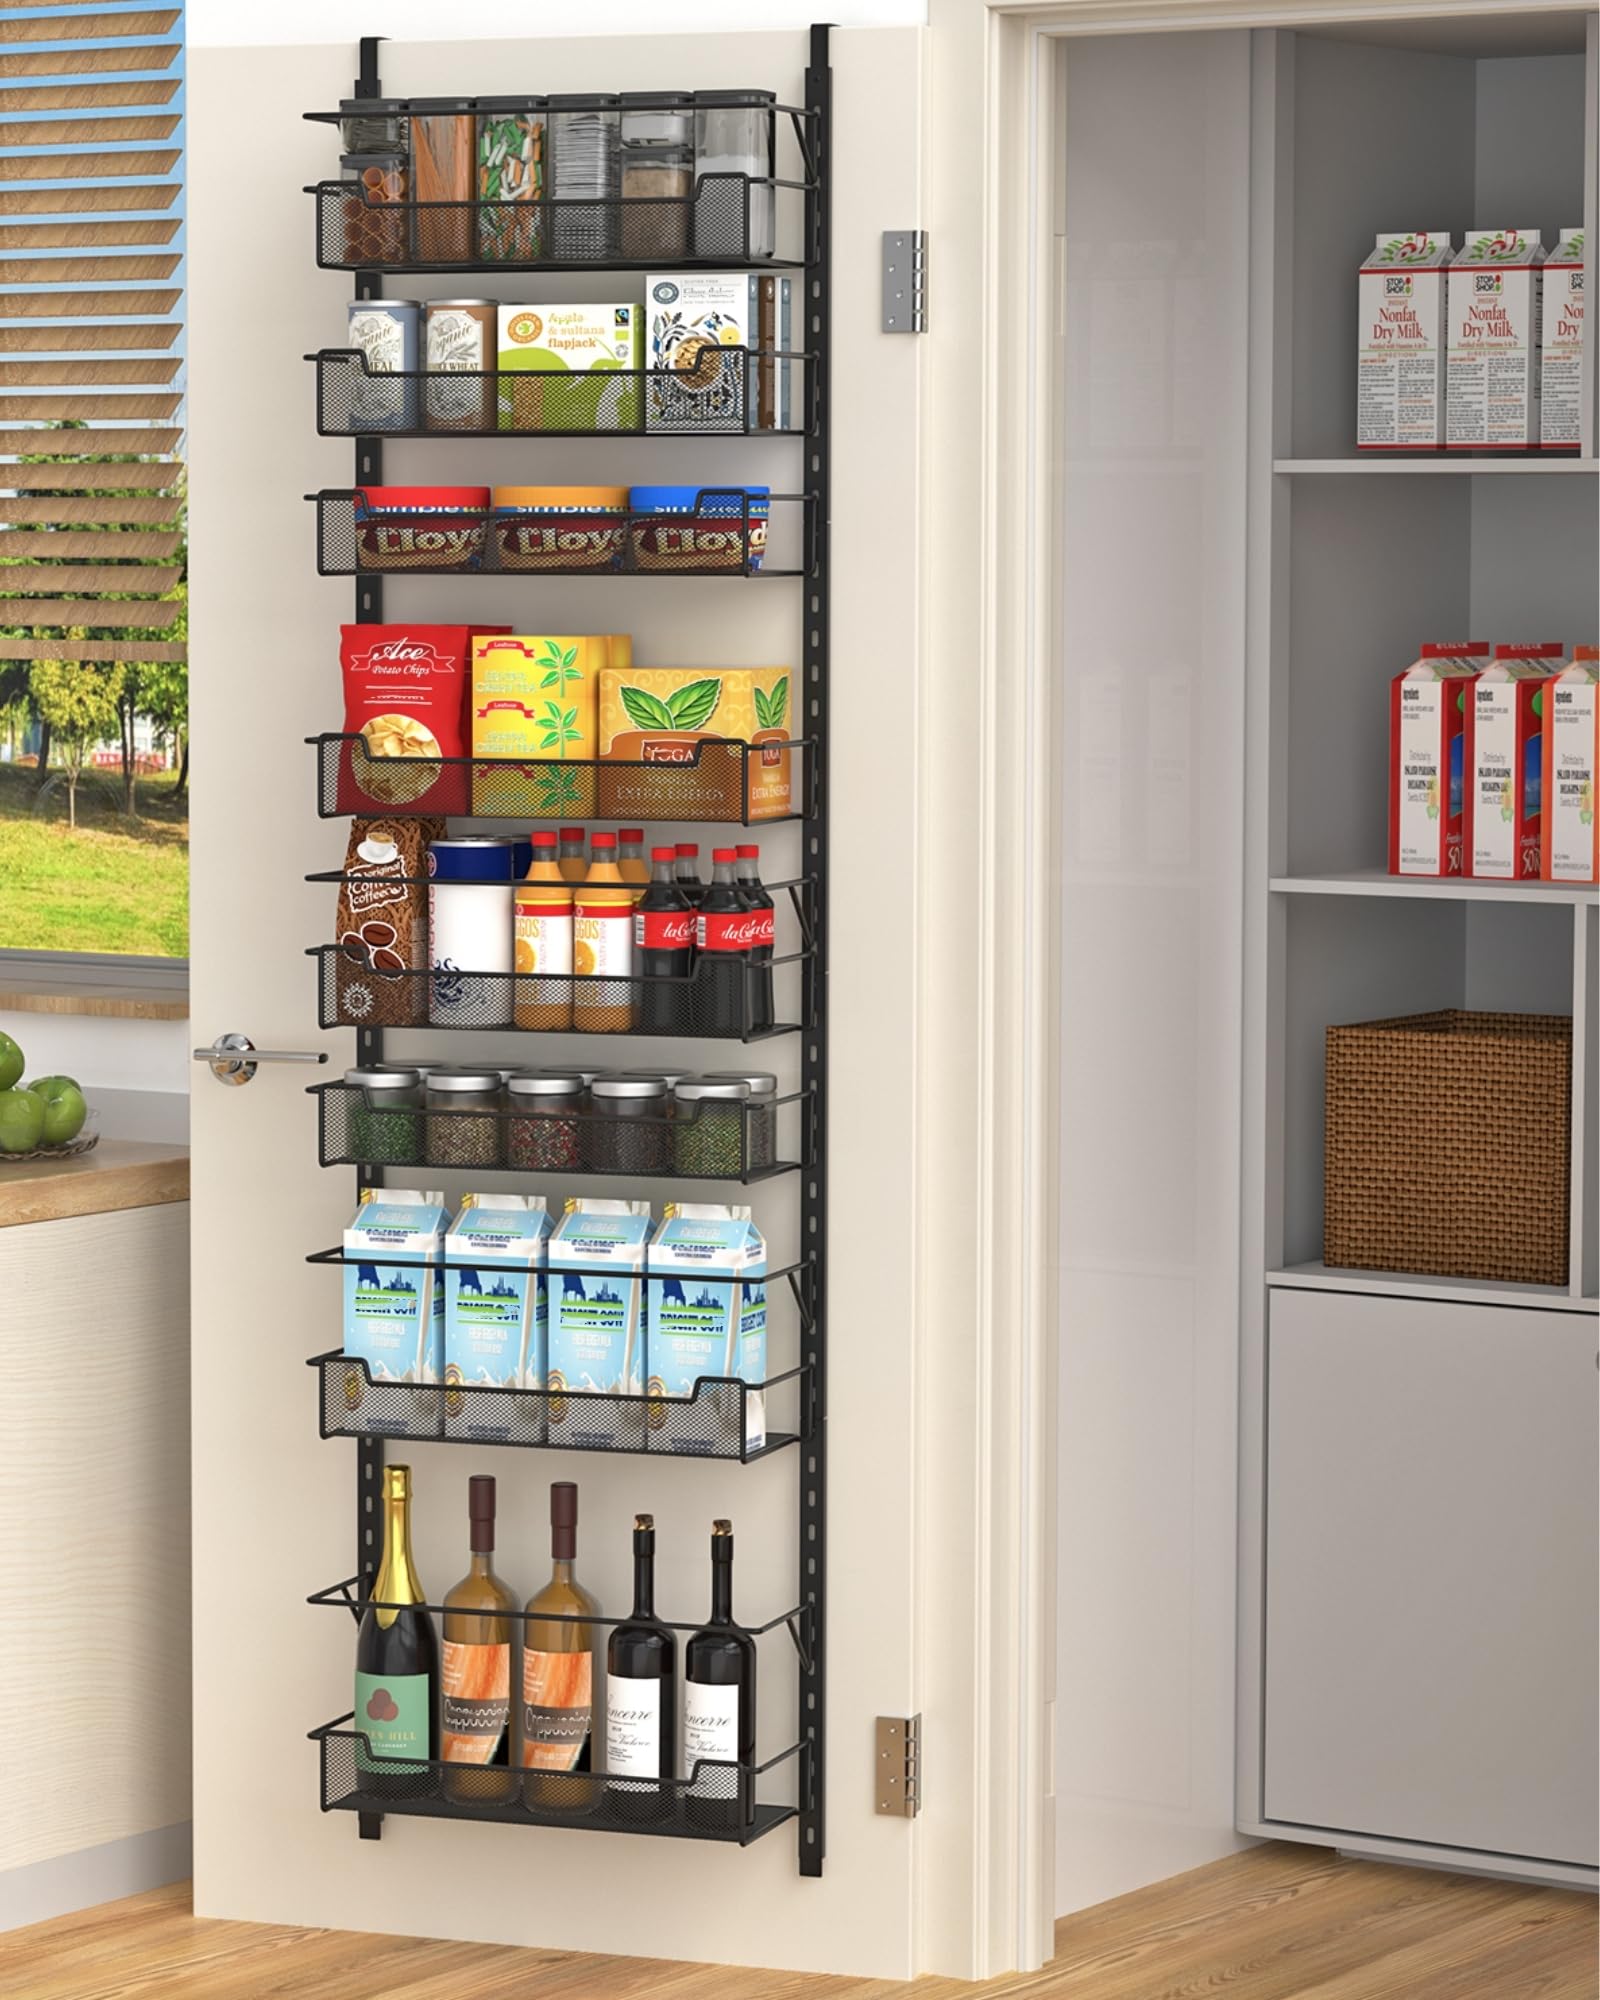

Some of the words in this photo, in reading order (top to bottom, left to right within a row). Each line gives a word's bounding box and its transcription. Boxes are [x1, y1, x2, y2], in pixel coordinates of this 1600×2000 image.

[1386, 277, 1404, 286] STOP
[1475, 275, 1494, 284] STOP
[1379, 305, 1416, 322] Nonfat
[1469, 304, 1507, 320] Nonfat
[559, 325, 605, 335] sultana
[1373, 324, 1394, 344] Dry
[1397, 322, 1424, 339] Milk
[1462, 322, 1484, 342] Dry
[1487, 320, 1514, 337] Milk
[1558, 320, 1580, 340] Dry
[548, 338, 597, 350] flapjack
[372, 636, 430, 660] Ace
[372, 665, 401, 675] Potato
[403, 663, 431, 678] Chips
[353, 890, 388, 905] coffee
